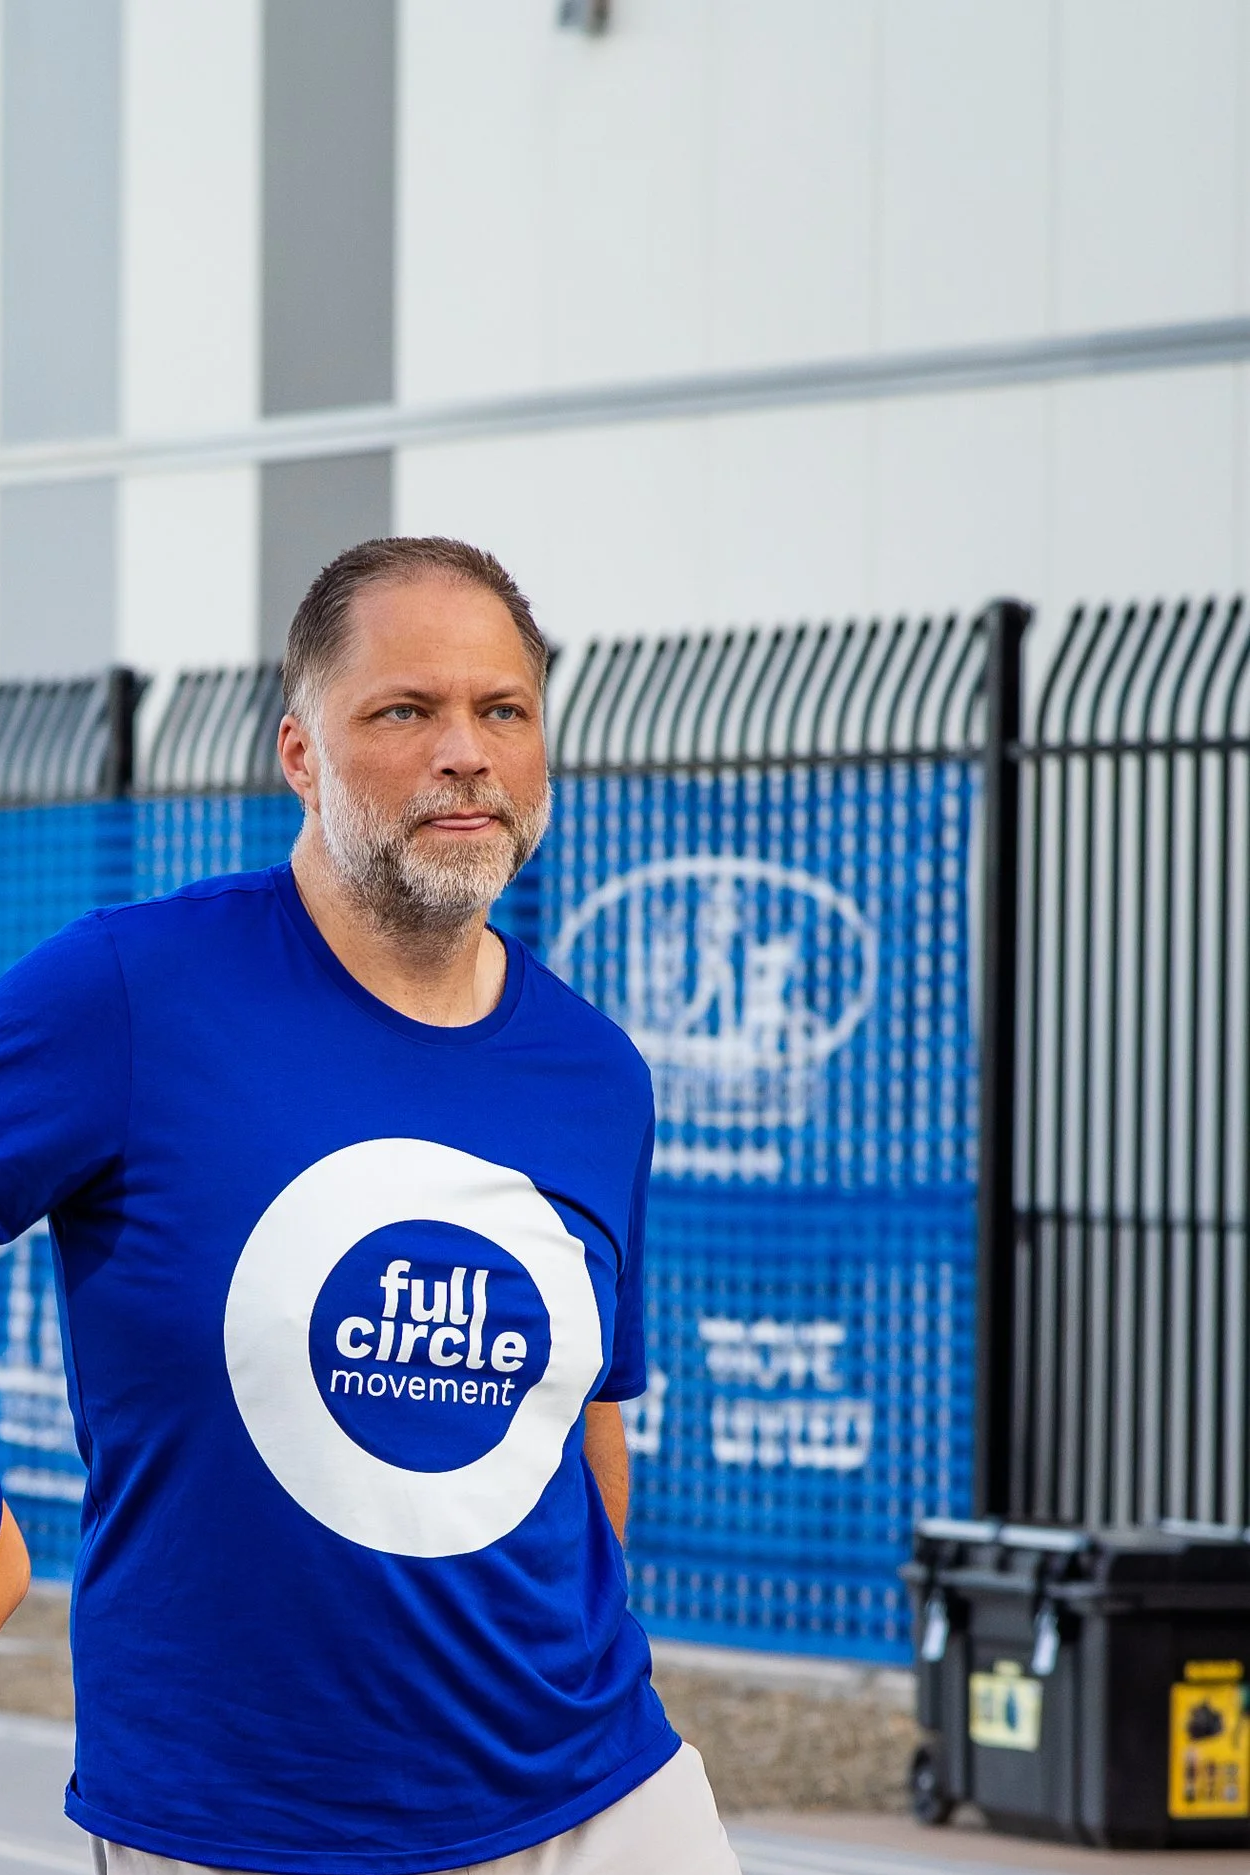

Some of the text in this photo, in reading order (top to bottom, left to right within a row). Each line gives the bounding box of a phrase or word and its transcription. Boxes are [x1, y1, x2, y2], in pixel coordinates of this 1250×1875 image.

[380, 1260, 489, 1325] full
[336, 1316, 527, 1372] circle
[330, 1369, 515, 1406] movement
